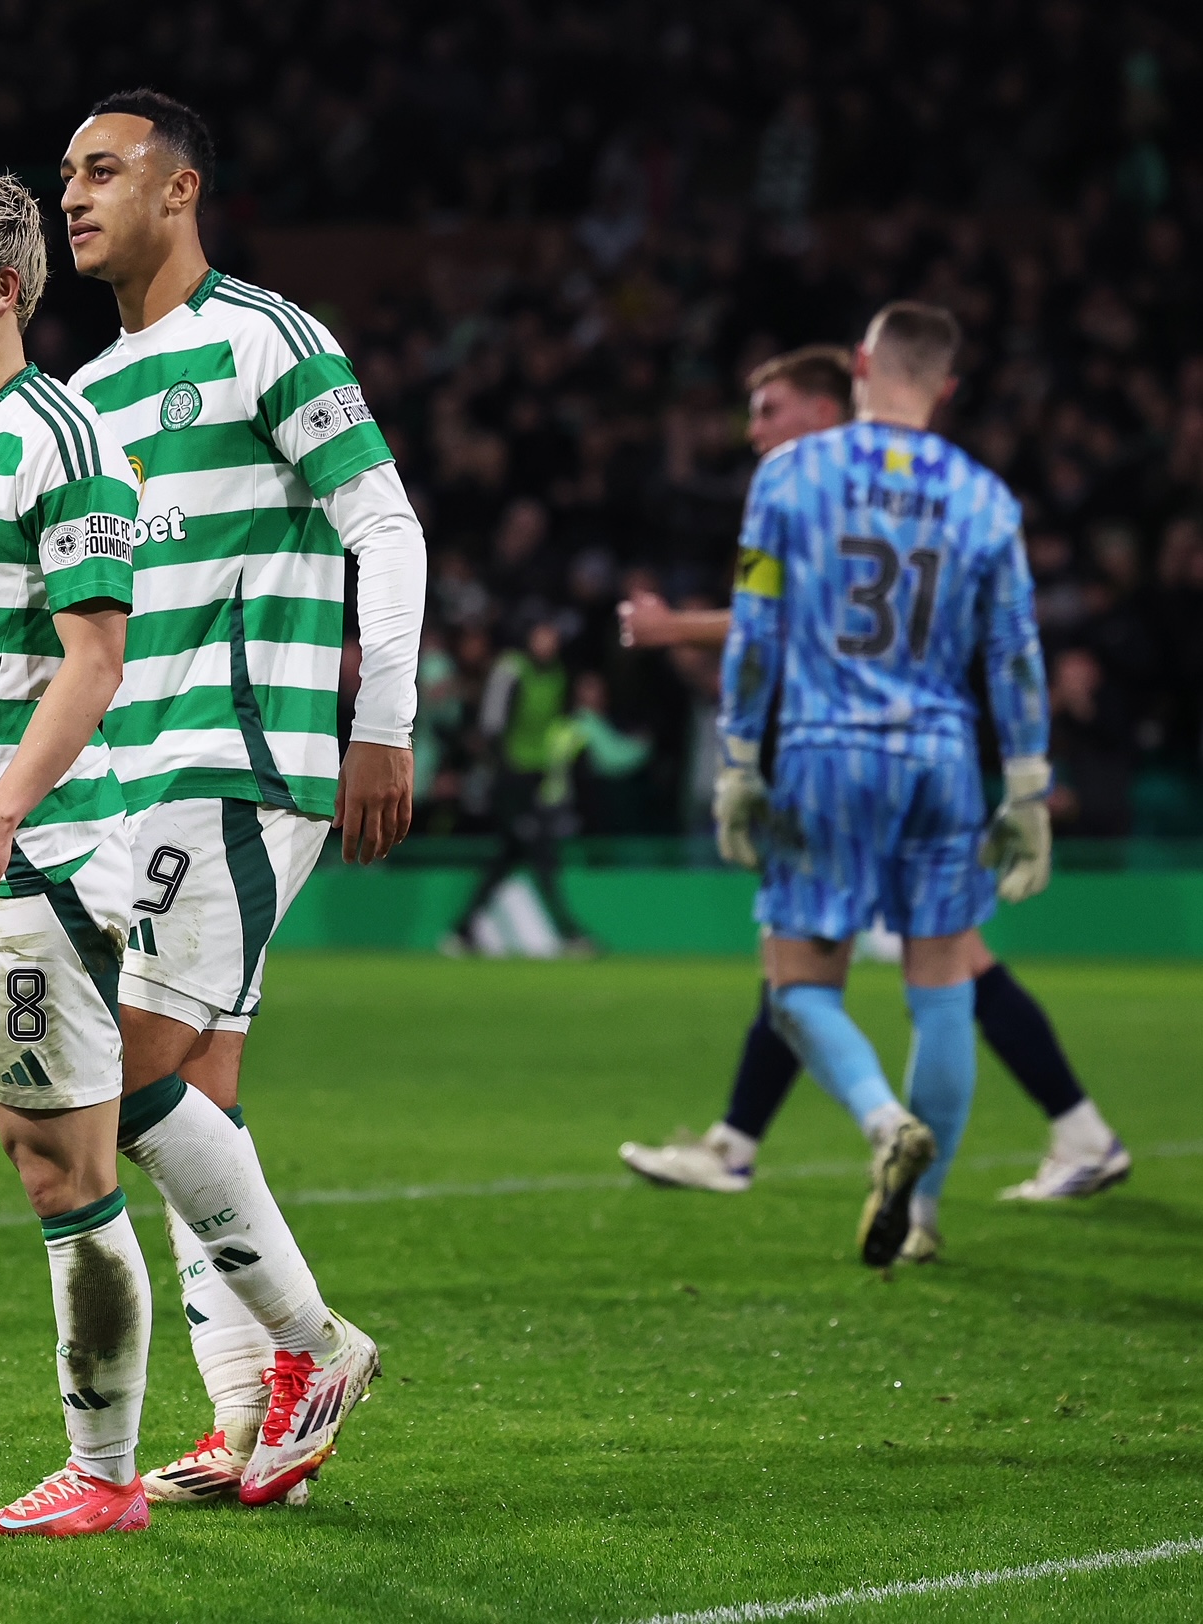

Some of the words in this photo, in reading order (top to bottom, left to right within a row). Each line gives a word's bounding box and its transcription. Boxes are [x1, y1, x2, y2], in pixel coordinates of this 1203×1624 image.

[85, 515, 119, 536] CELTIC
[121, 520, 130, 541] FC
[837, 535, 940, 662] 31
[132, 845, 192, 915] 9
